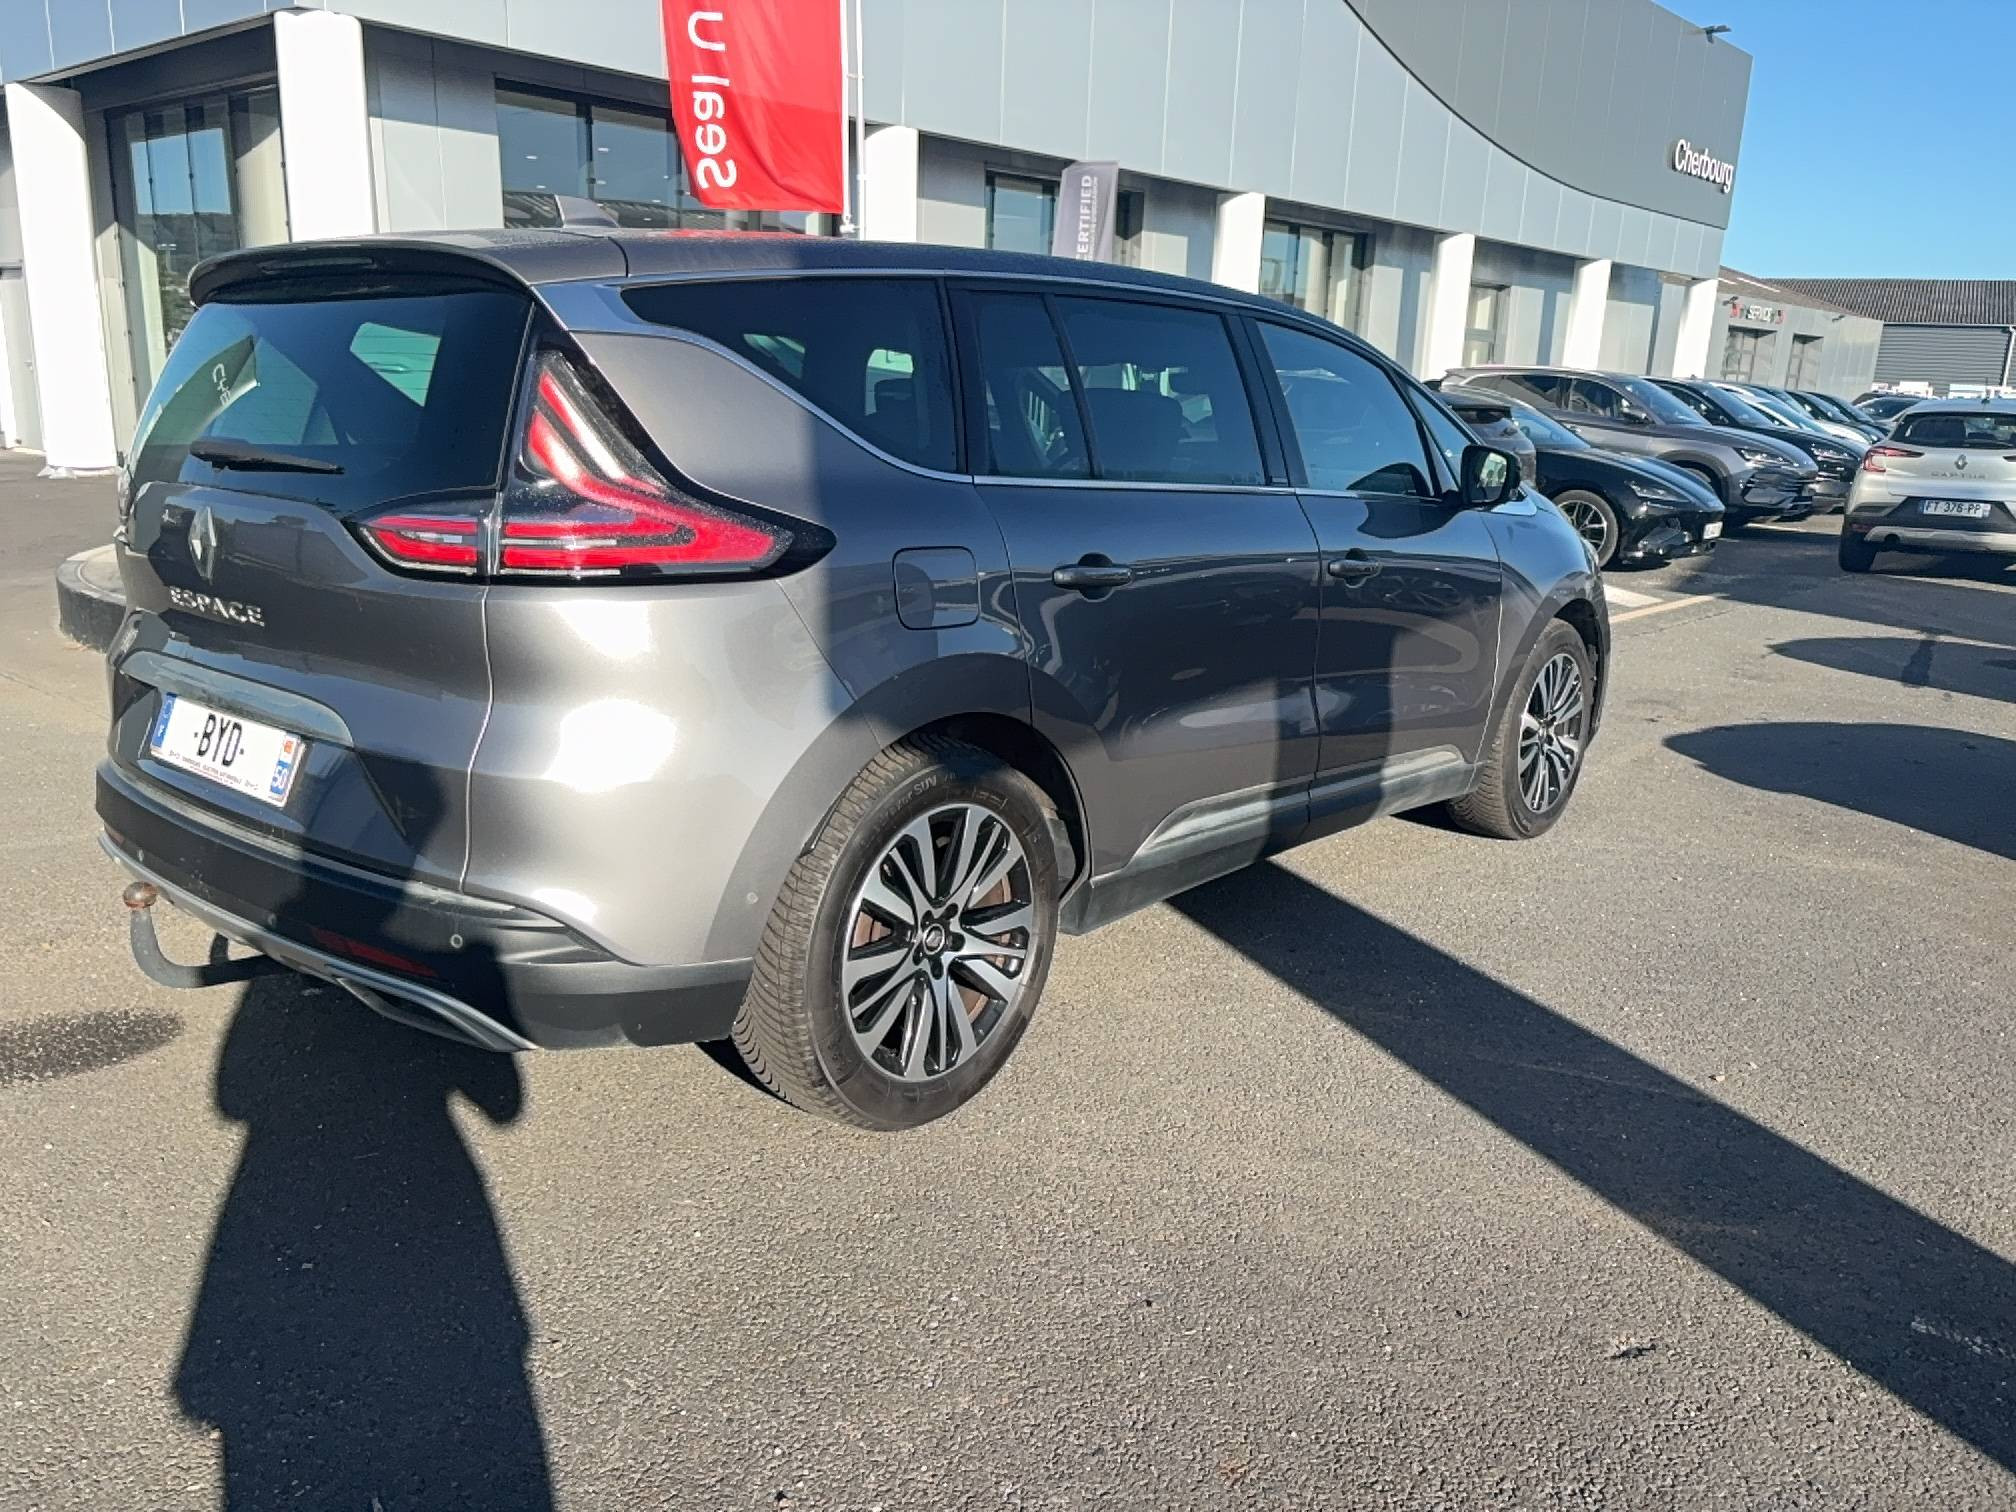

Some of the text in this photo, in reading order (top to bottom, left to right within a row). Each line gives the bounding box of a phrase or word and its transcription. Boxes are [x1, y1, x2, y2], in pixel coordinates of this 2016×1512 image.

[1674, 138, 1734, 194] Cherbourg
[170, 585, 266, 628] ESPACE
[196, 713, 243, 767] BYD
[913, 774, 937, 795] SUV
